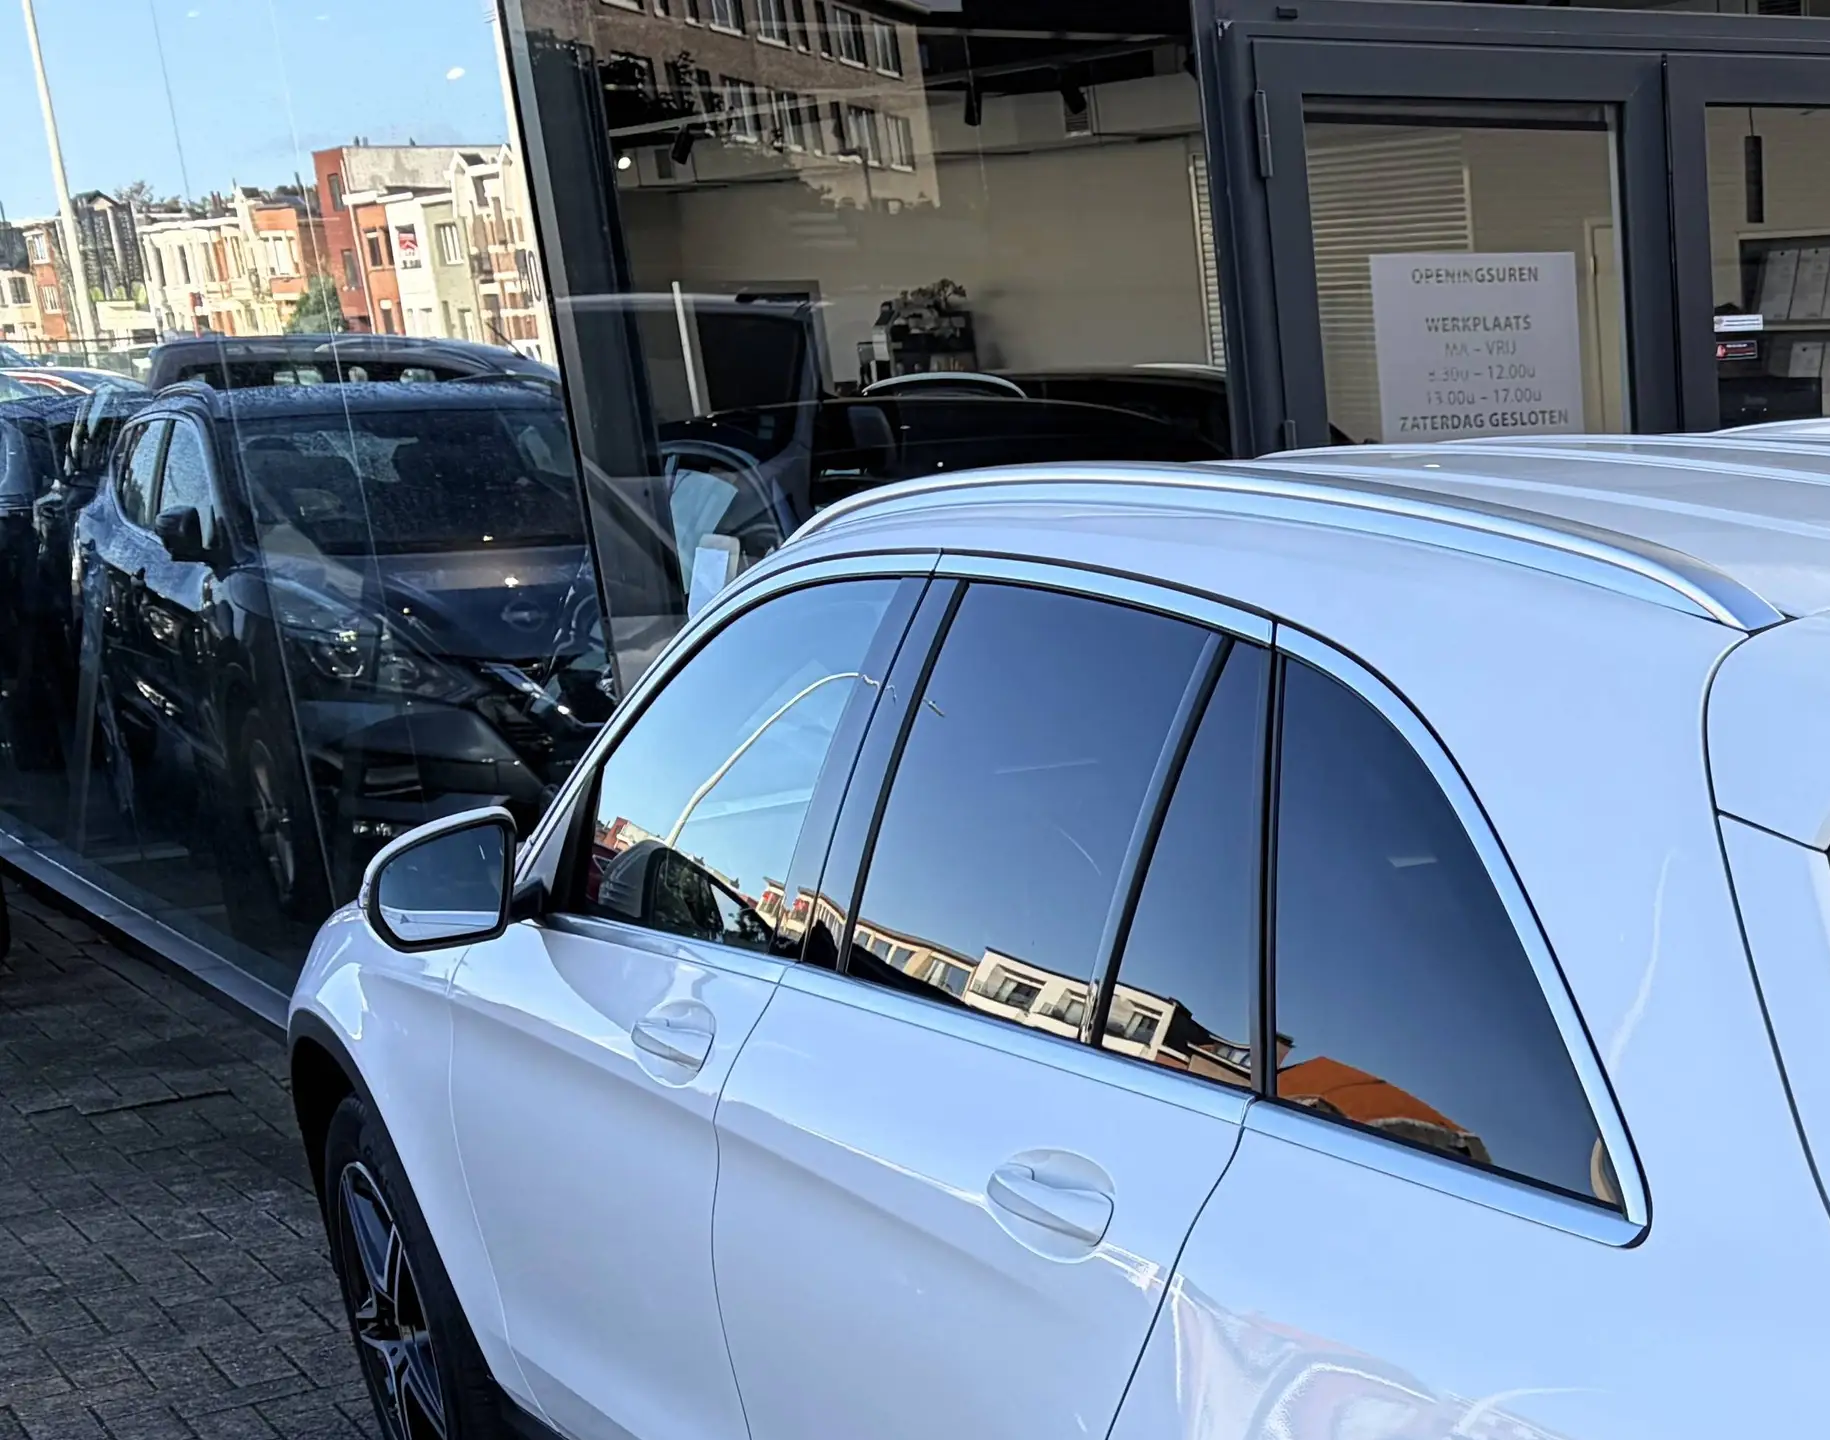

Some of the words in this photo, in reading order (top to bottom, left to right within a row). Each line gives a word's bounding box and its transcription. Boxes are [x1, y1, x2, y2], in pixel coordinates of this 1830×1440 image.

[1411, 266, 1539, 284] OPENINGSUREN
[1425, 314, 1532, 333] WERKPLAATS
[1485, 340, 1517, 356] VRIJ
[1487, 364, 1536, 380] 12.00u
[1494, 388, 1543, 404] 17.00u
[1399, 413, 1485, 432] ZATERDAG
[1488, 409, 1569, 428] GESLOTEN
